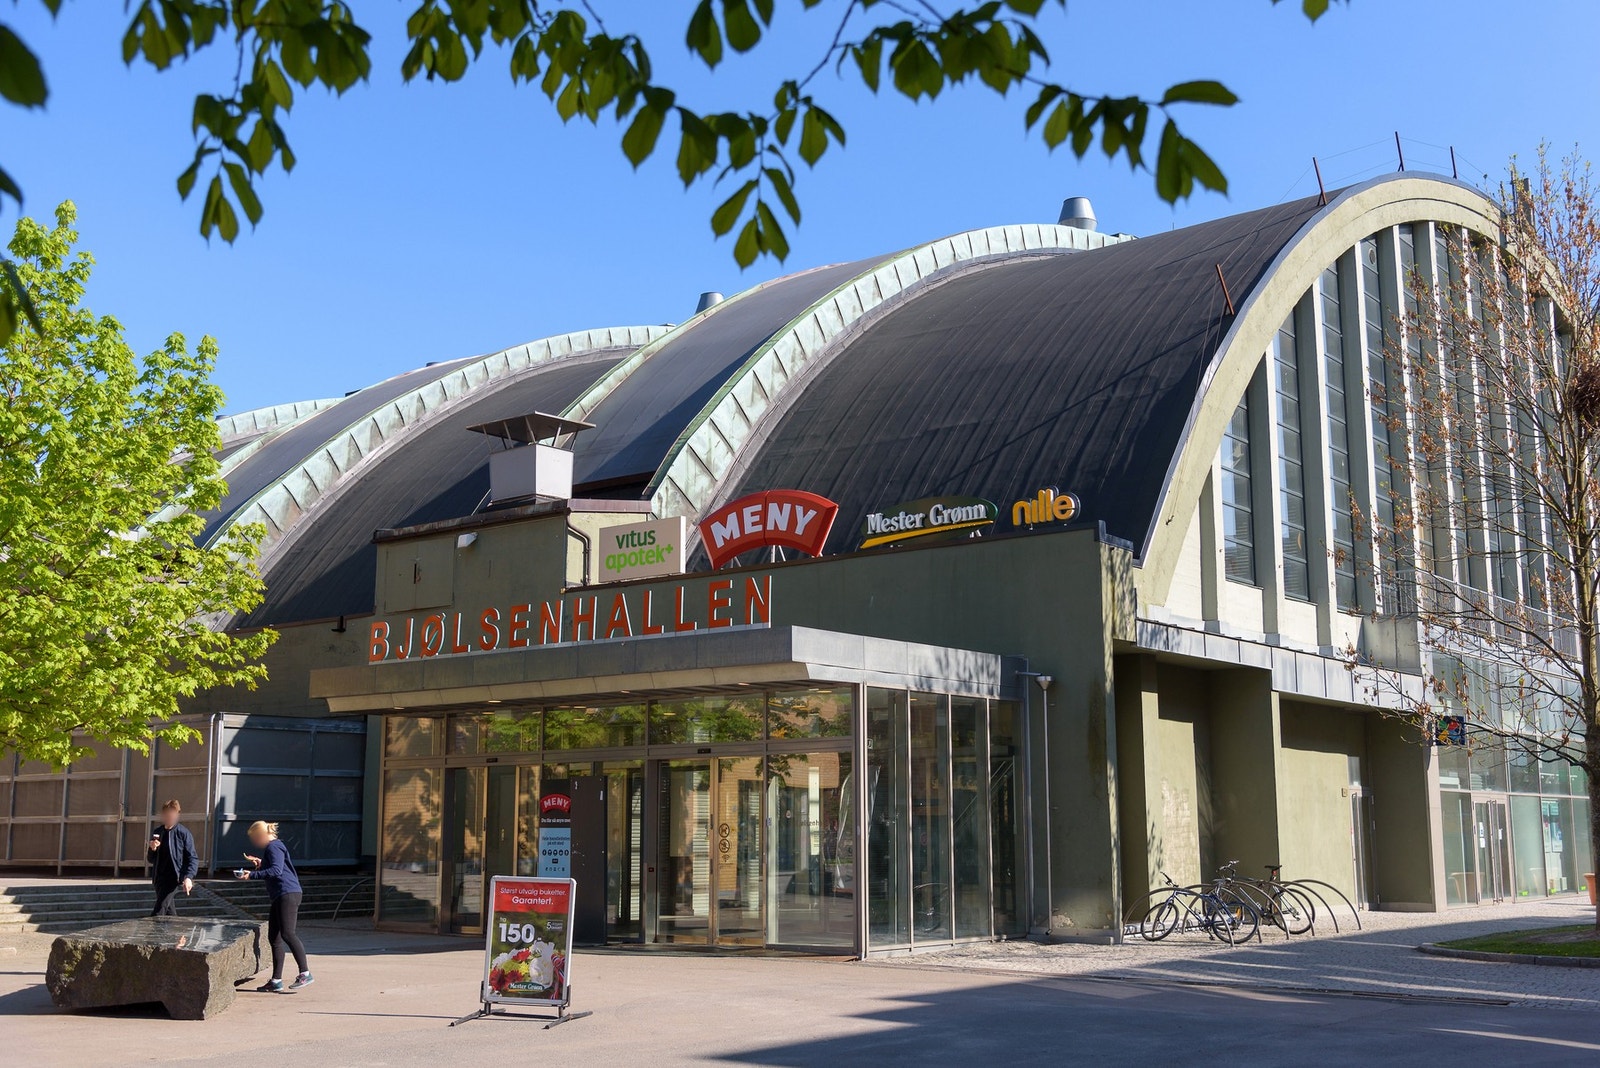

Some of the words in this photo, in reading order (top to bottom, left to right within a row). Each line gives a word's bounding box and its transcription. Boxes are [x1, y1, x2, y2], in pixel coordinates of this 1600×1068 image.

[866, 511, 926, 536] Mester
[929, 502, 987, 526] Grønn
[1012, 486, 1077, 527] nille
[710, 502, 818, 549] MENY
[615, 529, 656, 550] vitus
[368, 574, 772, 663] BJØLSENHALLEN
[543, 797, 569, 809] MENY
[511, 895, 554, 905] Garantert.
[519, 888, 538, 896] utvalg
